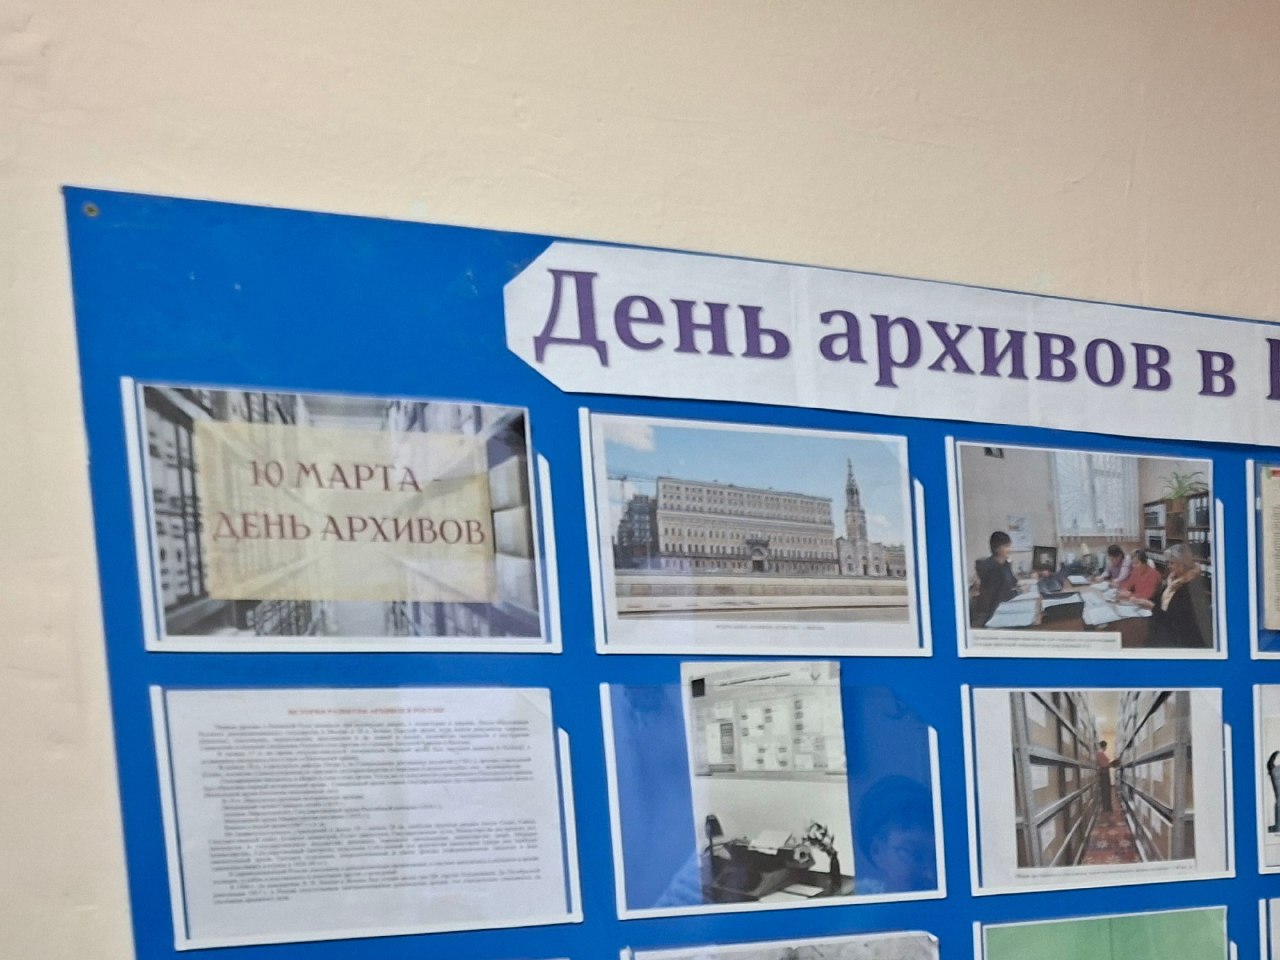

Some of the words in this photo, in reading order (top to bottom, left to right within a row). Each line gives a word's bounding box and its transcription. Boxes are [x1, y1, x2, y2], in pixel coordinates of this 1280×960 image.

[534, 269, 791, 366] День
[819, 309, 1172, 392] архивов
[1196, 349, 1236, 398] в
[250, 460, 284, 488] 10
[296, 461, 422, 492] МАРТА
[212, 511, 311, 542] ДЕНЬ
[320, 514, 486, 545] АРХИВОВ
